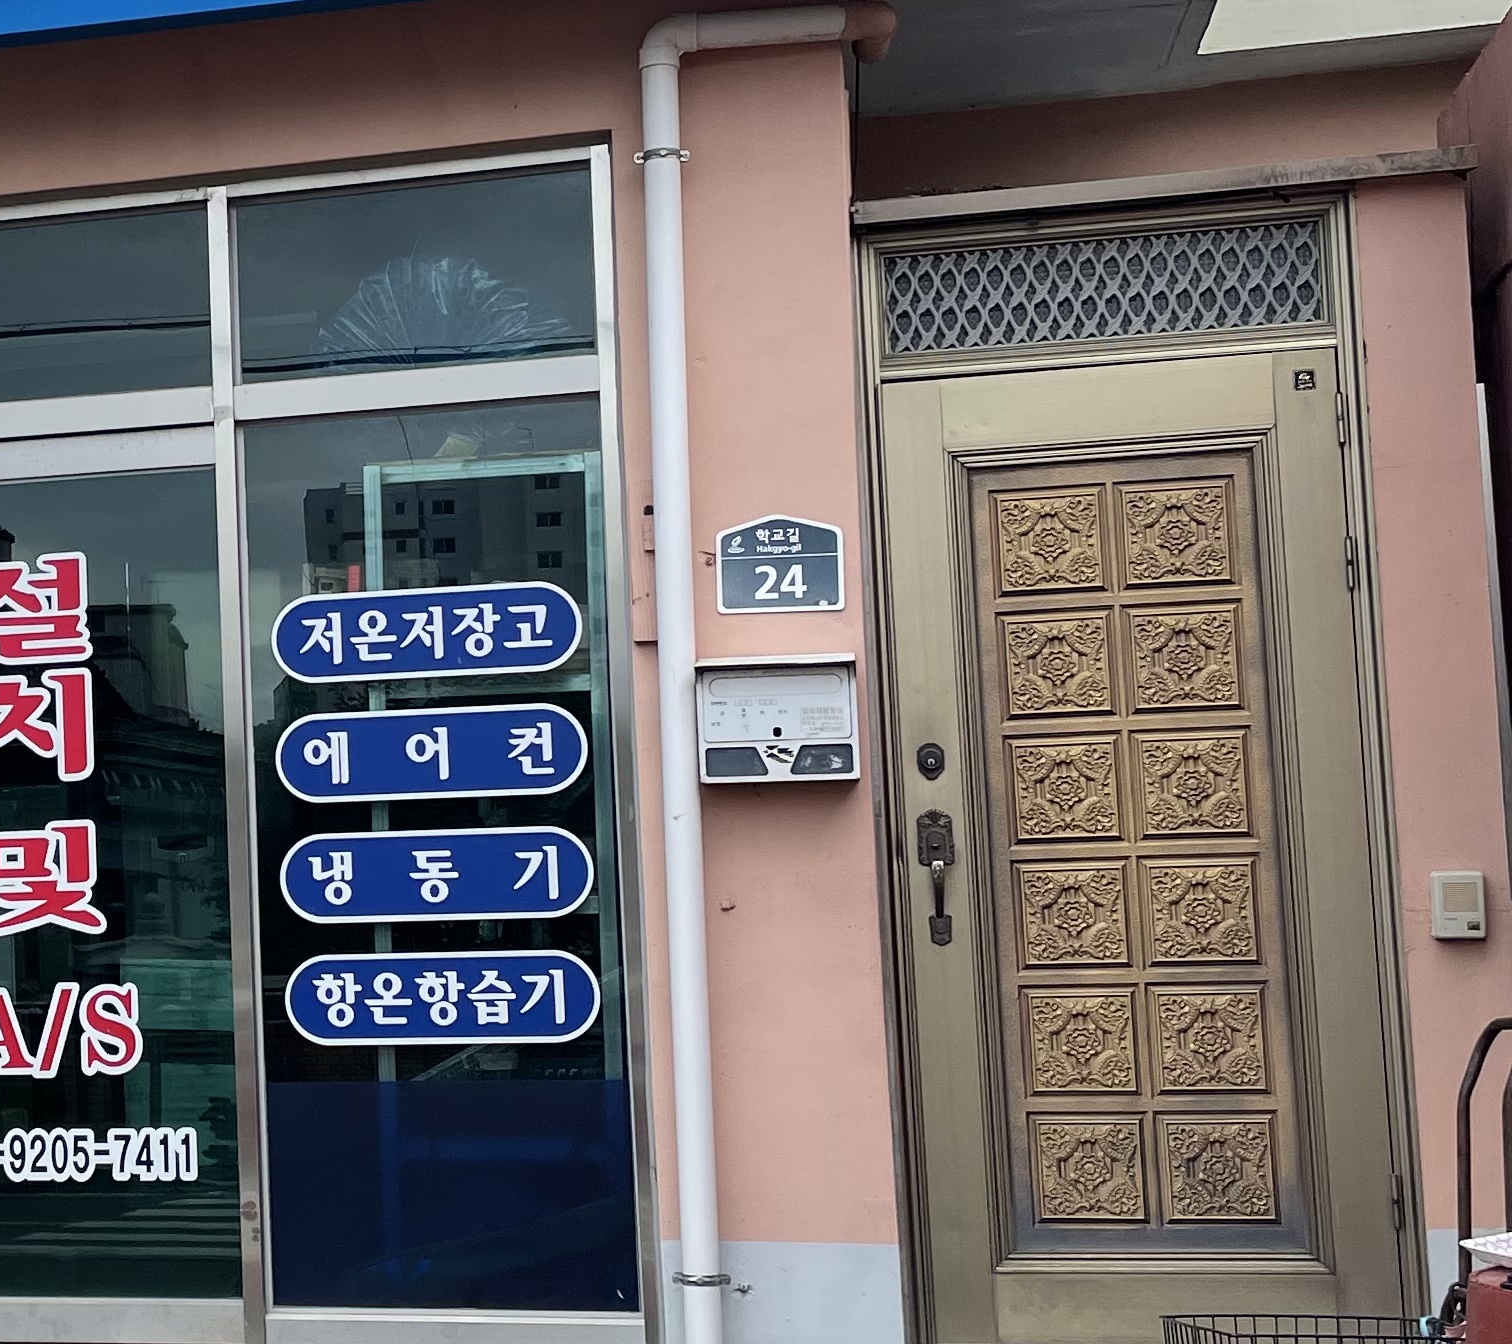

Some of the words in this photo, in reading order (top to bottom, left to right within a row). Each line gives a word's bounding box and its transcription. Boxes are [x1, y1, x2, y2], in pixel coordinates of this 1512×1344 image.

[755, 527, 800, 544] 학교길
[755, 543, 802, 554] Hakgyo-gil
[754, 563, 808, 600] 24
[298, 602, 554, 666] 저온저장고
[302, 721, 556, 786] 에어컨
[307, 845, 561, 906] 냉동기
[311, 969, 567, 1028] 항온항습기
